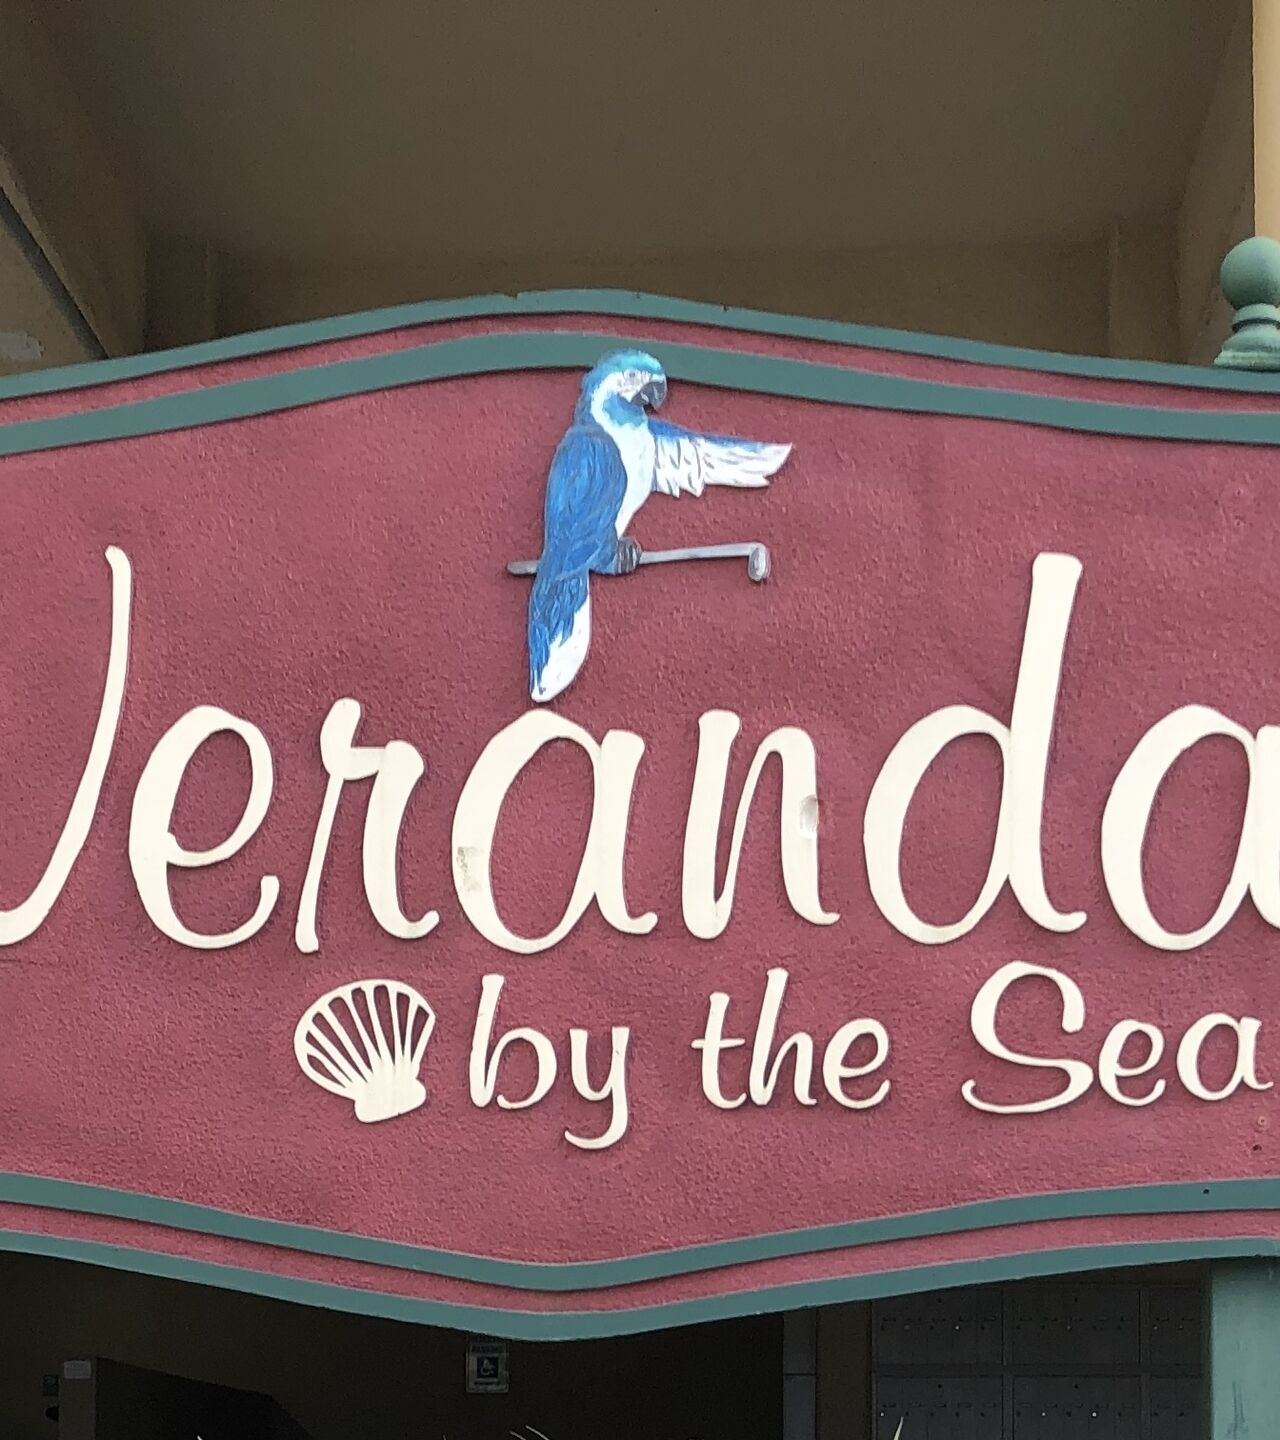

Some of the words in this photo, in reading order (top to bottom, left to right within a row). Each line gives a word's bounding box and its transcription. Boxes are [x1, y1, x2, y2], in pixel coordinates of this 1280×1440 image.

[469, 973, 630, 1149] by
[691, 967, 890, 1109] the
[961, 960, 1274, 1114] Sea
